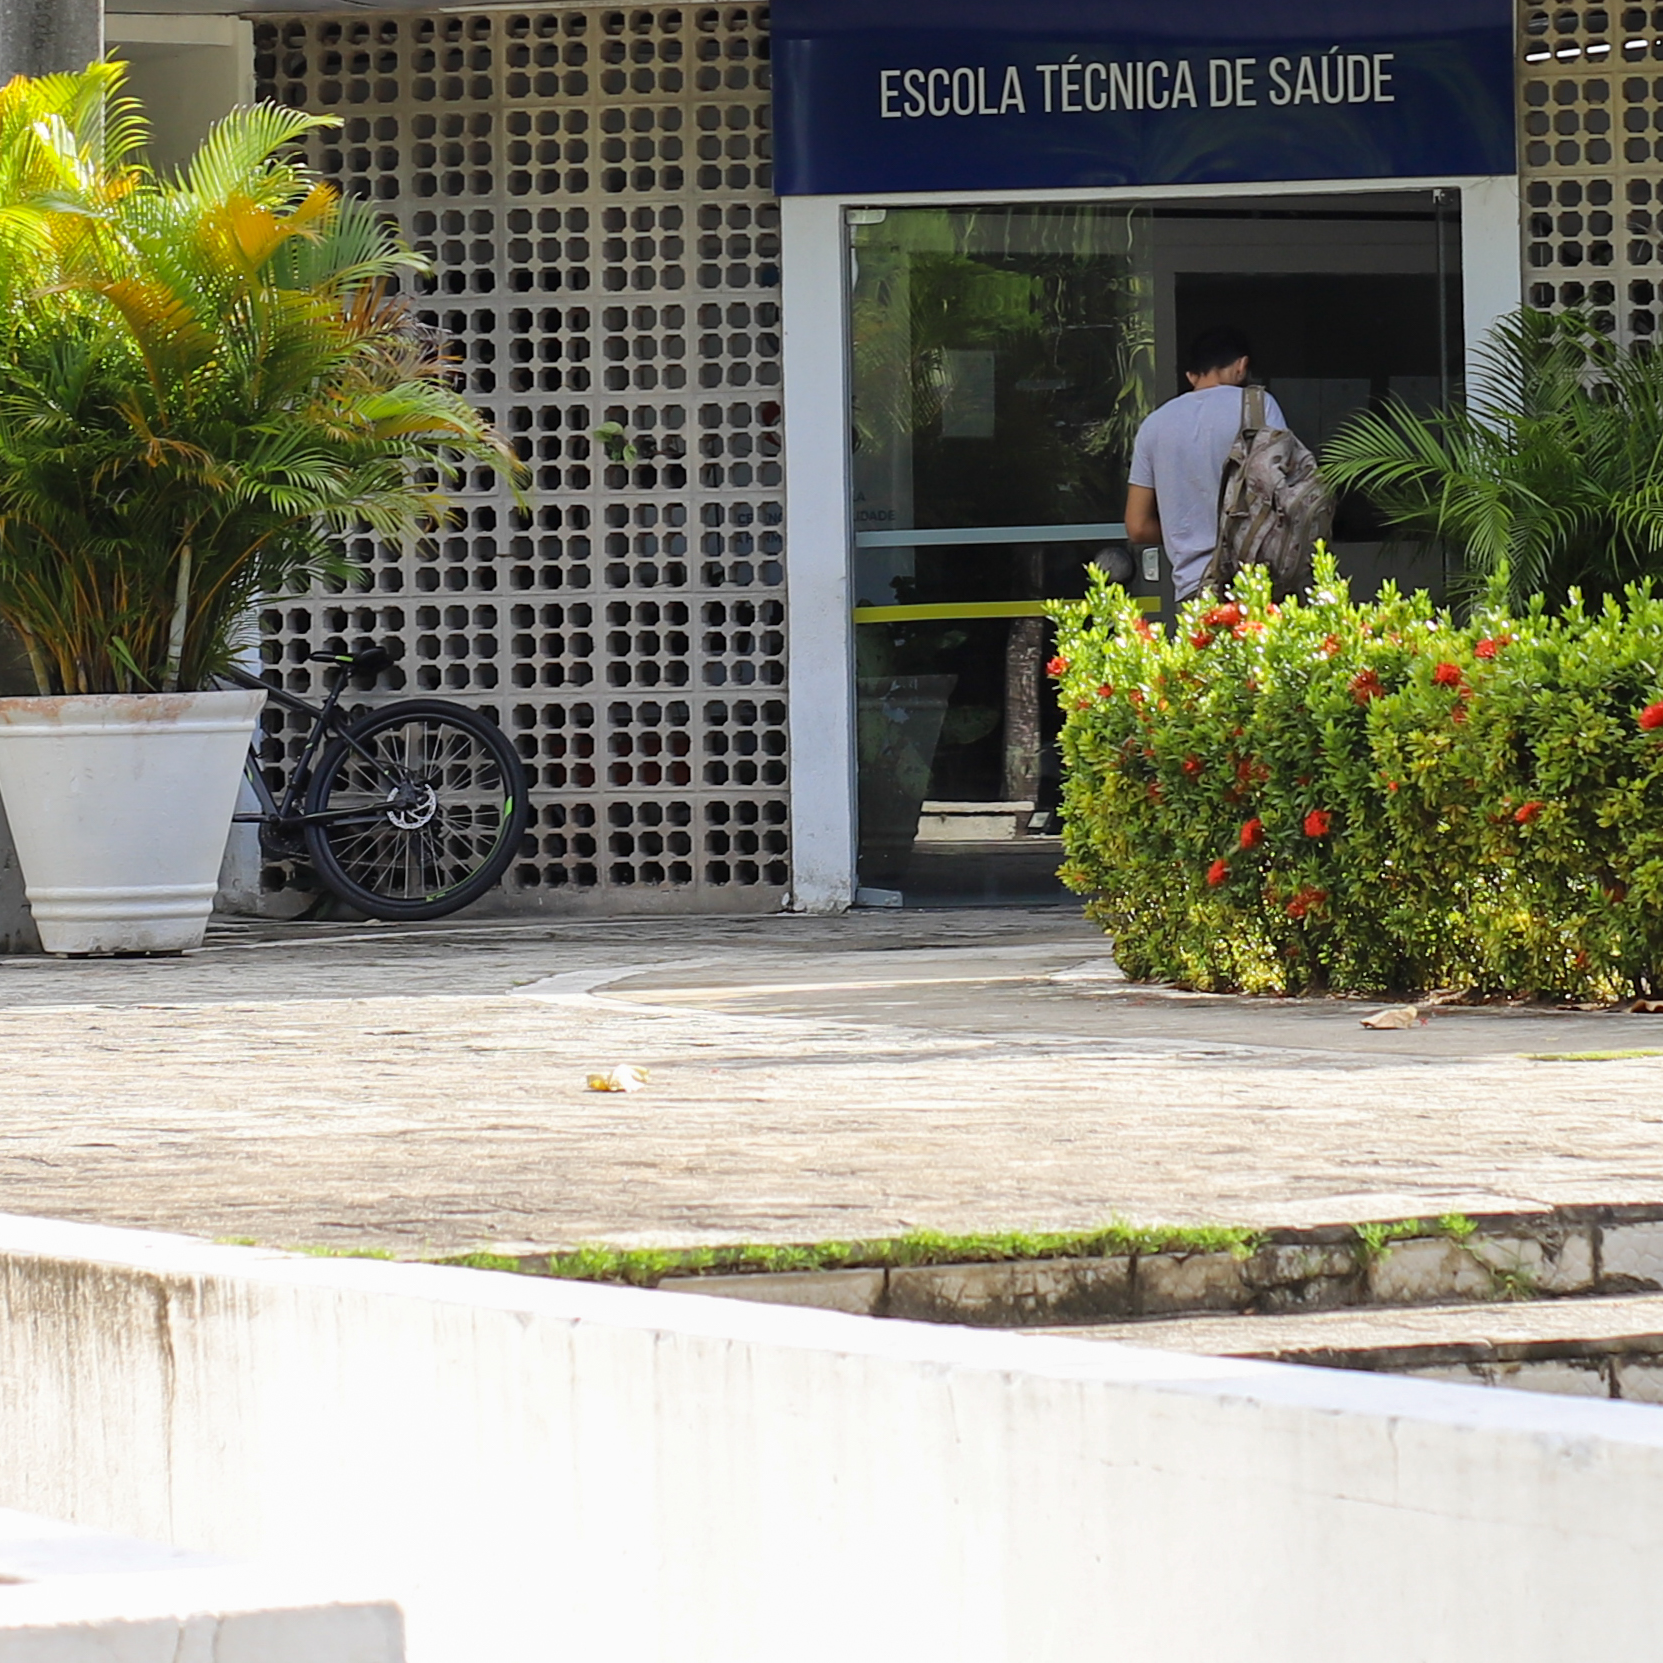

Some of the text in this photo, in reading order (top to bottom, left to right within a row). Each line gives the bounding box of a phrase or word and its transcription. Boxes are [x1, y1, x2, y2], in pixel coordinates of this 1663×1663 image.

[880, 45, 1395, 119] ESCOLA TÉCNICA DE SAÚDE
